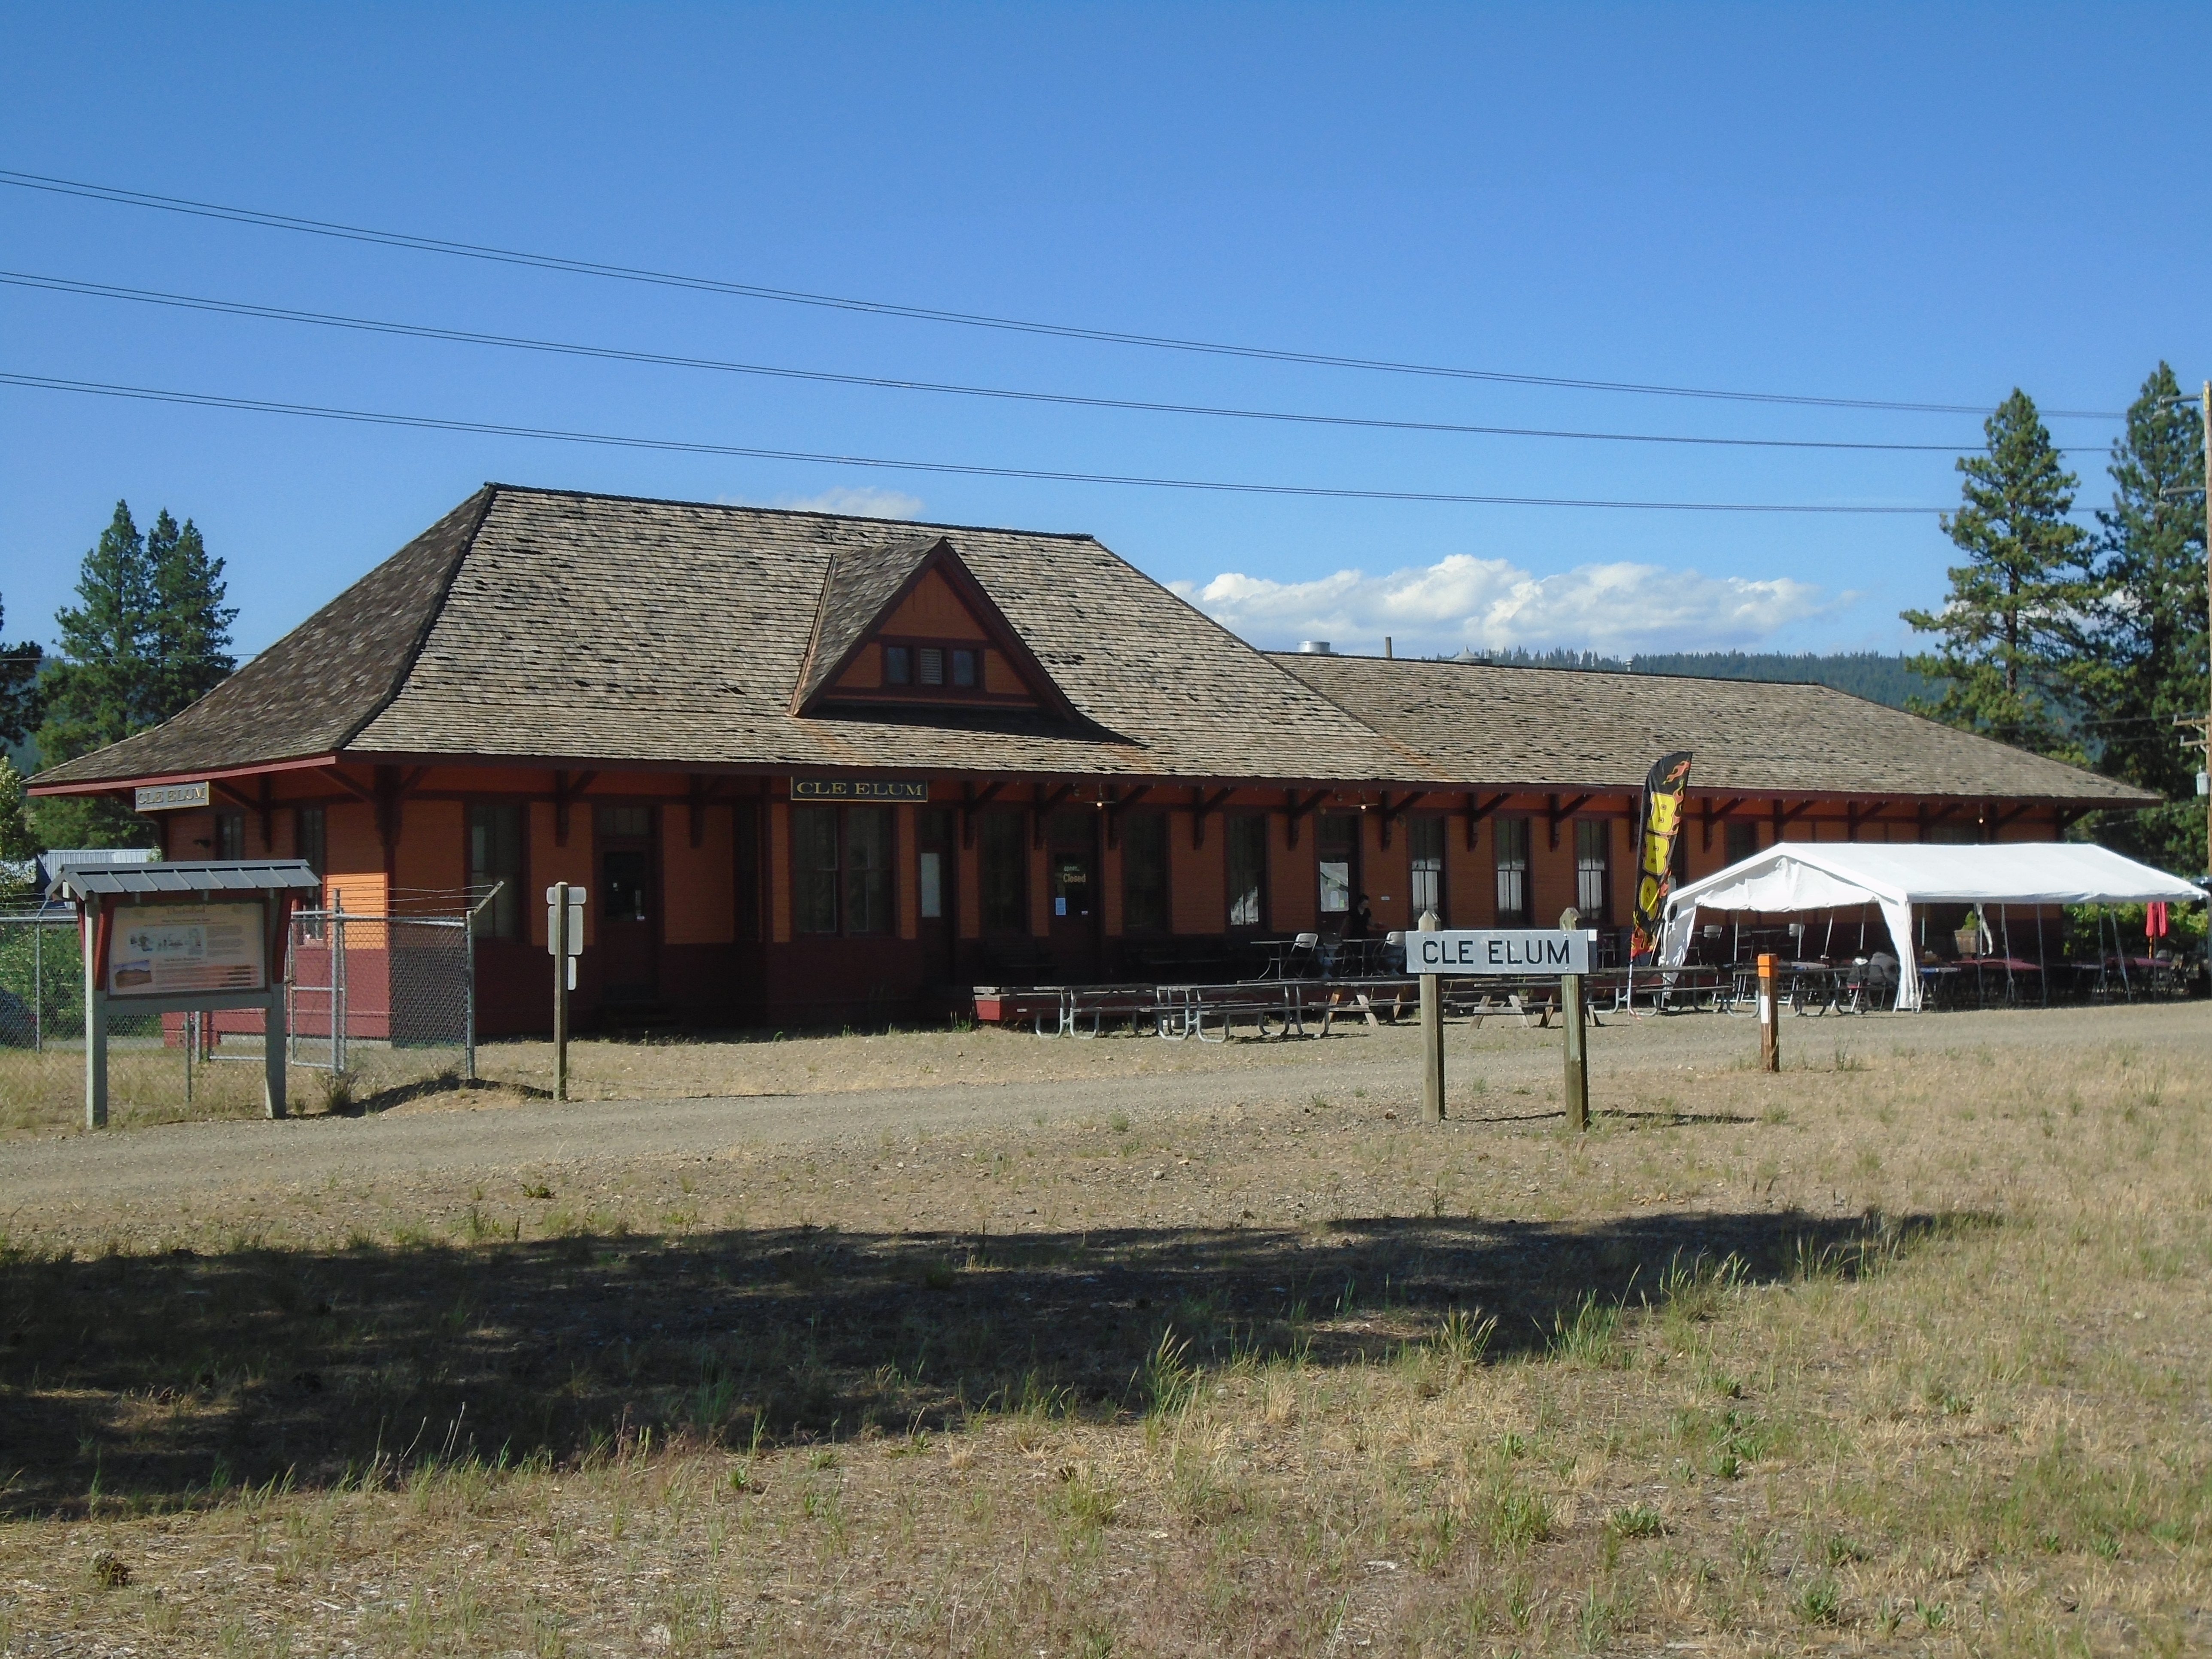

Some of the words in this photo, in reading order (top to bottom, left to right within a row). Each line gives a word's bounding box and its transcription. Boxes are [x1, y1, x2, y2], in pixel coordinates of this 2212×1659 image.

[138, 790, 164, 805] CLE
[167, 787, 205, 802] ELUM
[796, 782, 847, 795] CLE
[854, 783, 923, 796] ELUM
[1638, 791, 1678, 922] BBQ
[1063, 873, 1086, 883] Closed
[1422, 940, 1474, 964] CLE
[1488, 939, 1570, 964] ELUM
